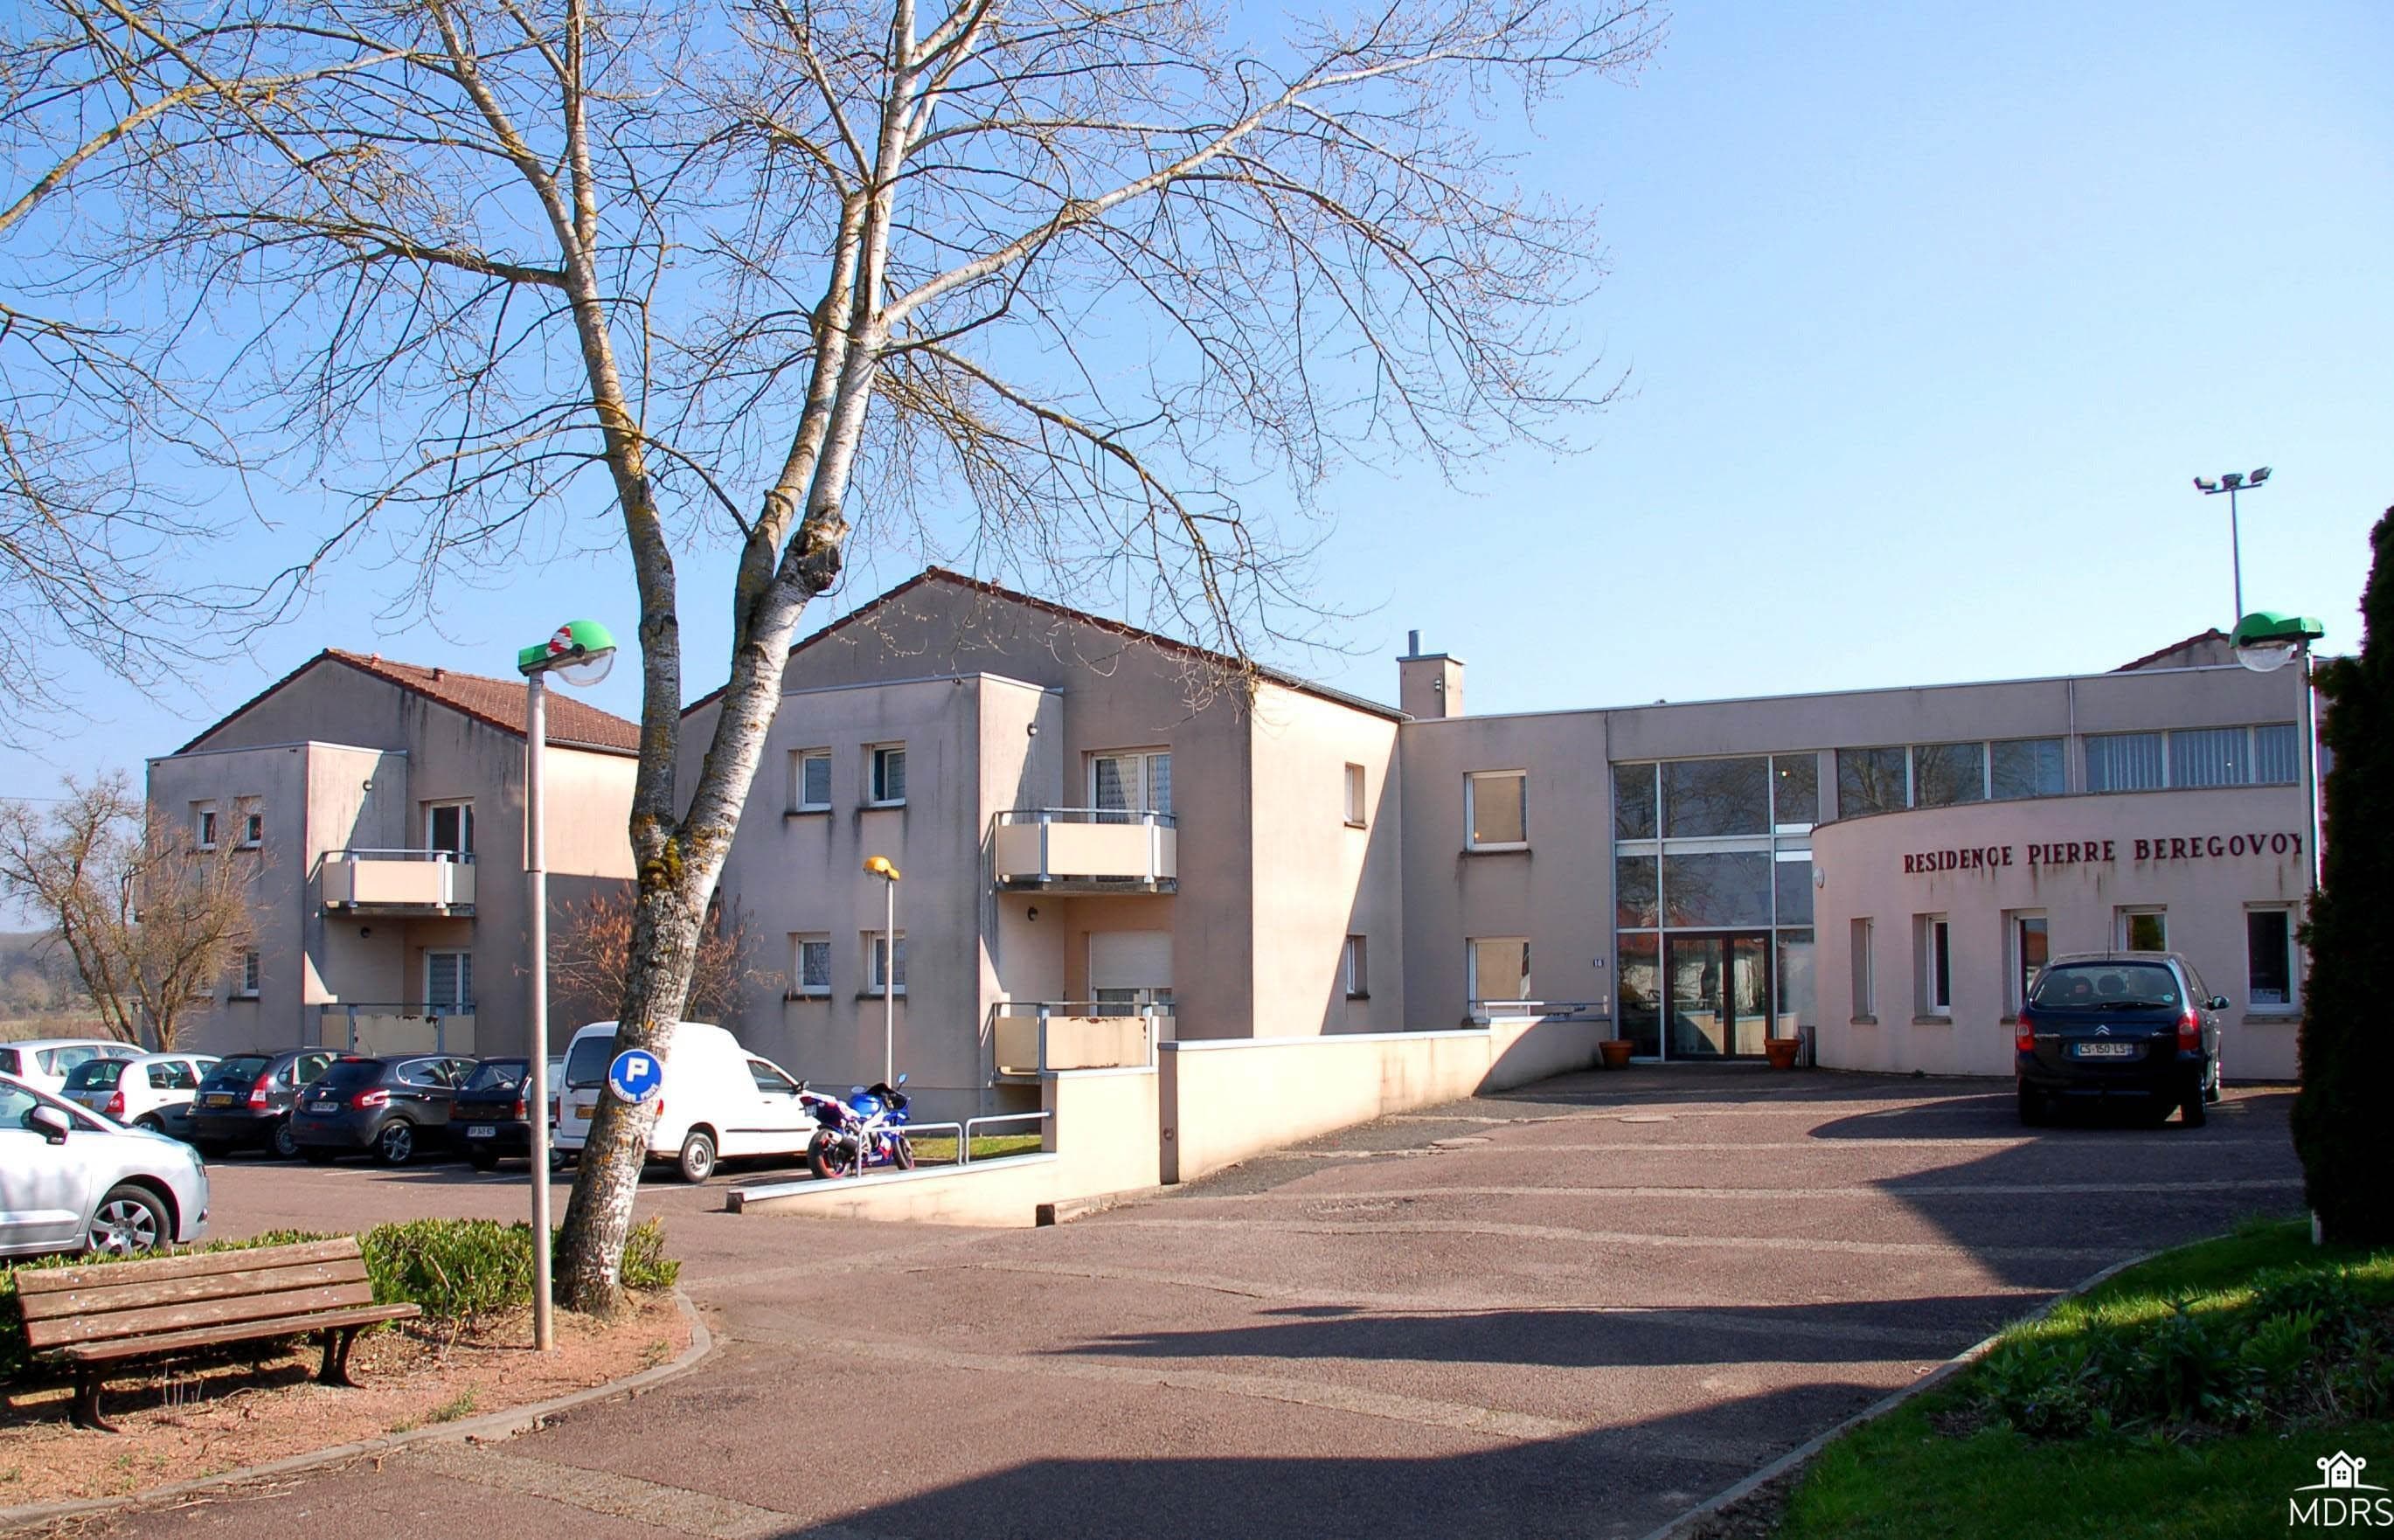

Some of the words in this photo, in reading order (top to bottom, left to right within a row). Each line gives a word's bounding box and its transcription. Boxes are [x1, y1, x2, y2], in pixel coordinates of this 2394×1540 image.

[1904, 845, 2012, 874] RESIDENCE
[2028, 840, 2115, 865] PIERRE
[2134, 833, 2303, 861] BEREGOVOY
[626, 1057, 649, 1083] P
